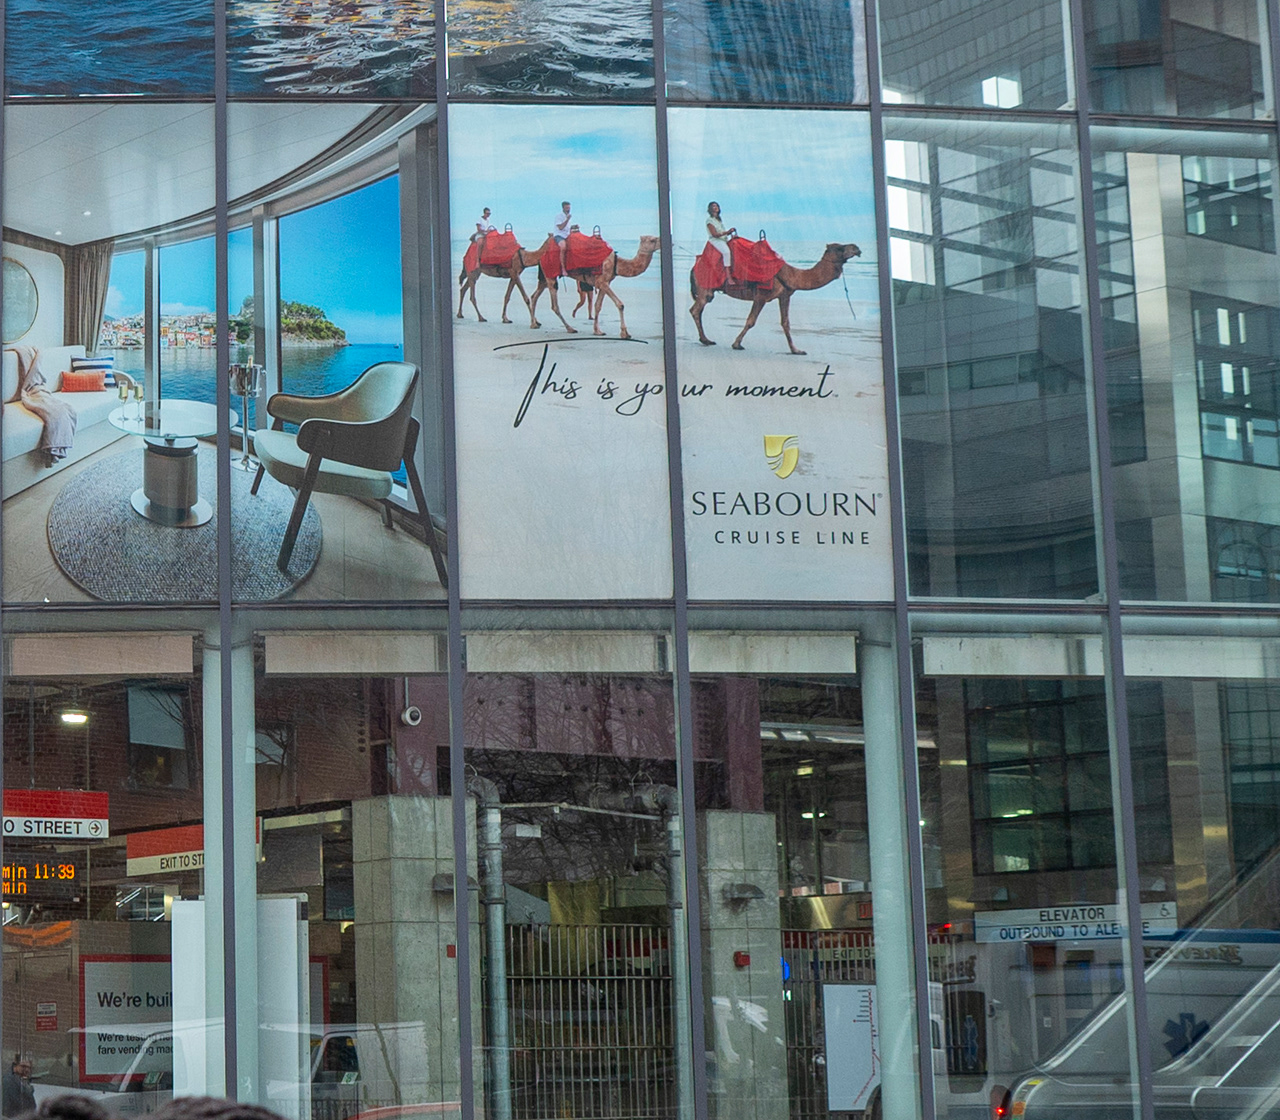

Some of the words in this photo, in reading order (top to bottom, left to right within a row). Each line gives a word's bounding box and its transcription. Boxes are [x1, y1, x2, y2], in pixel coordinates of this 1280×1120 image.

[493, 337, 648, 428] This
[596, 377, 620, 400] is
[616, 381, 713, 416] your
[714, 530, 801, 545] CRUISE
[816, 531, 870, 545] LINE
[4, 819, 15, 834] O
[23, 820, 83, 835] STREET
[160, 856, 178, 869] EXIT
[179, 855, 190, 868] TO
[1, 862, 27, 879] min
[34, 863, 76, 879] 11:39
[1, 879, 27, 894] min
[1039, 907, 1105, 922] ELEVATOR
[1000, 925, 1065, 940] OUTBOUND
[1071, 924, 1089, 937] TO
[1095, 921, 1150, 936] ALEE
[97, 991, 142, 1008] We're
[97, 1032, 124, 1042] We're
[97, 1044, 116, 1055] fare
